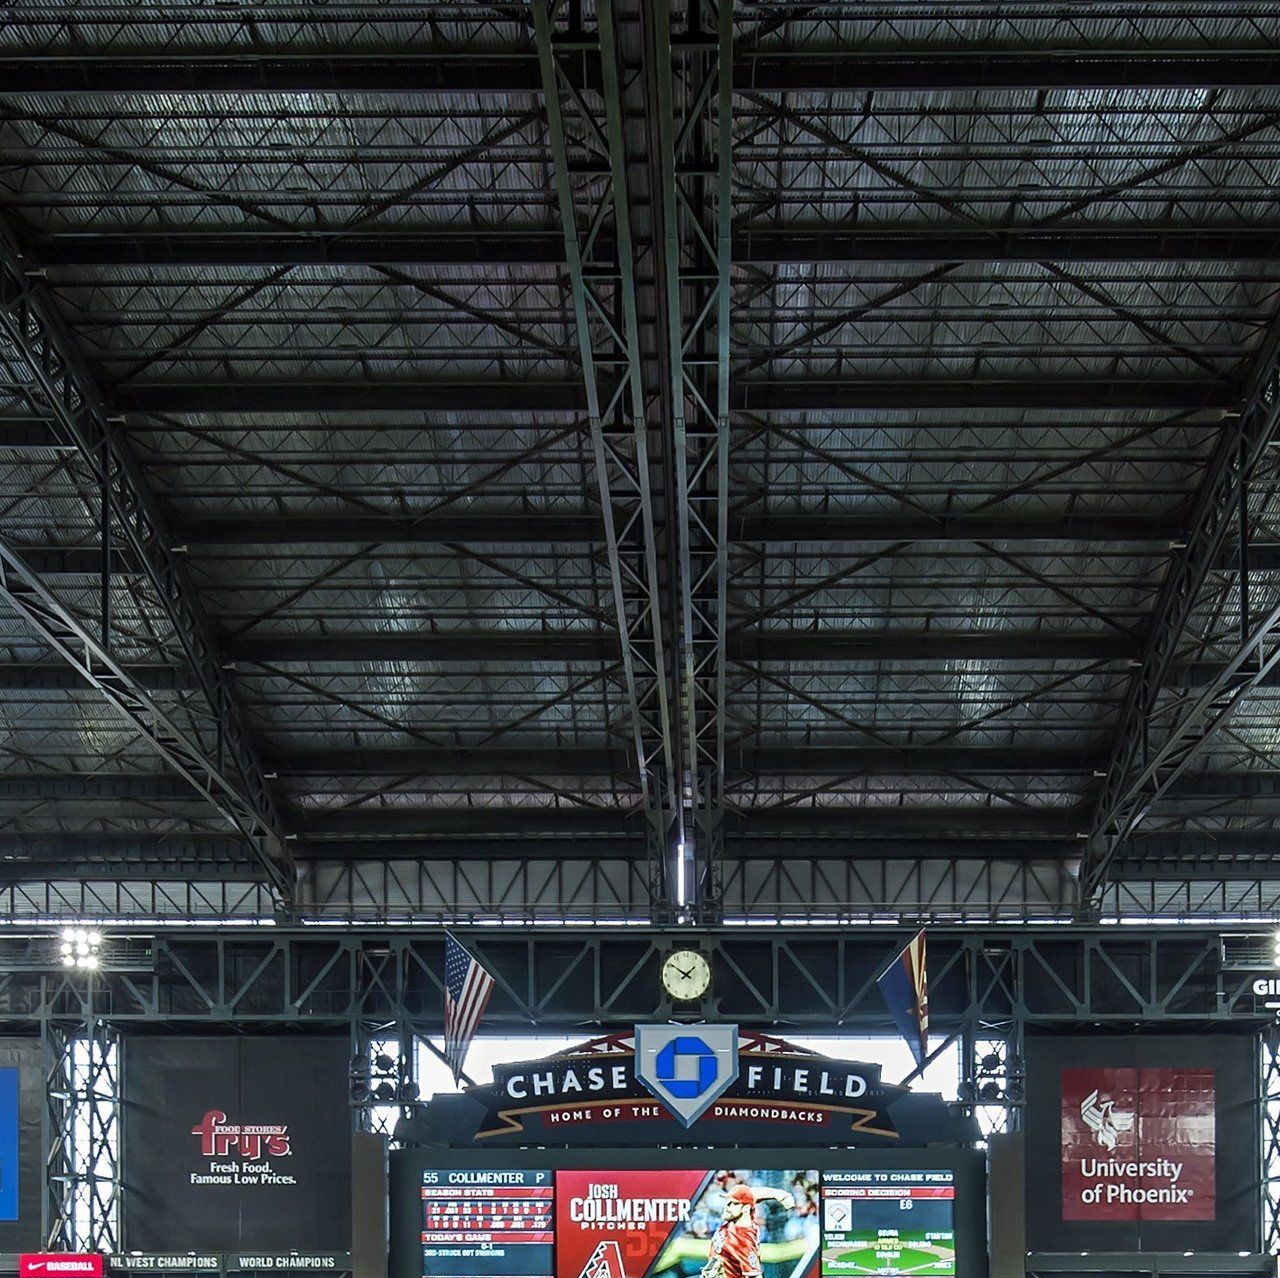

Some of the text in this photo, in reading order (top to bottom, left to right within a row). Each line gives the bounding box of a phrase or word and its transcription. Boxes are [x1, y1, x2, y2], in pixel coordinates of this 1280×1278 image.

[507, 1066, 867, 1099] CHASE FIELD
[551, 1107, 823, 1122] HOME OF THE DIAMONDBACKS
[210, 1161, 272, 1173] Fresh Food.
[1081, 1158, 1182, 1182] University
[191, 1173, 296, 1184] Famous Low Prices.
[424, 1173, 544, 1183] 55 COLLMENTER P
[587, 1184, 618, 1199] JOSH
[1082, 1184, 1103, 1203] of
[571, 1198, 691, 1221] COLLMENTER
[581, 1222, 646, 1230] PITCHER
[111, 1257, 217, 1267] NL WEST CHAMPIONS
[240, 1257, 335, 1267] WORLD CHAMPIONS
